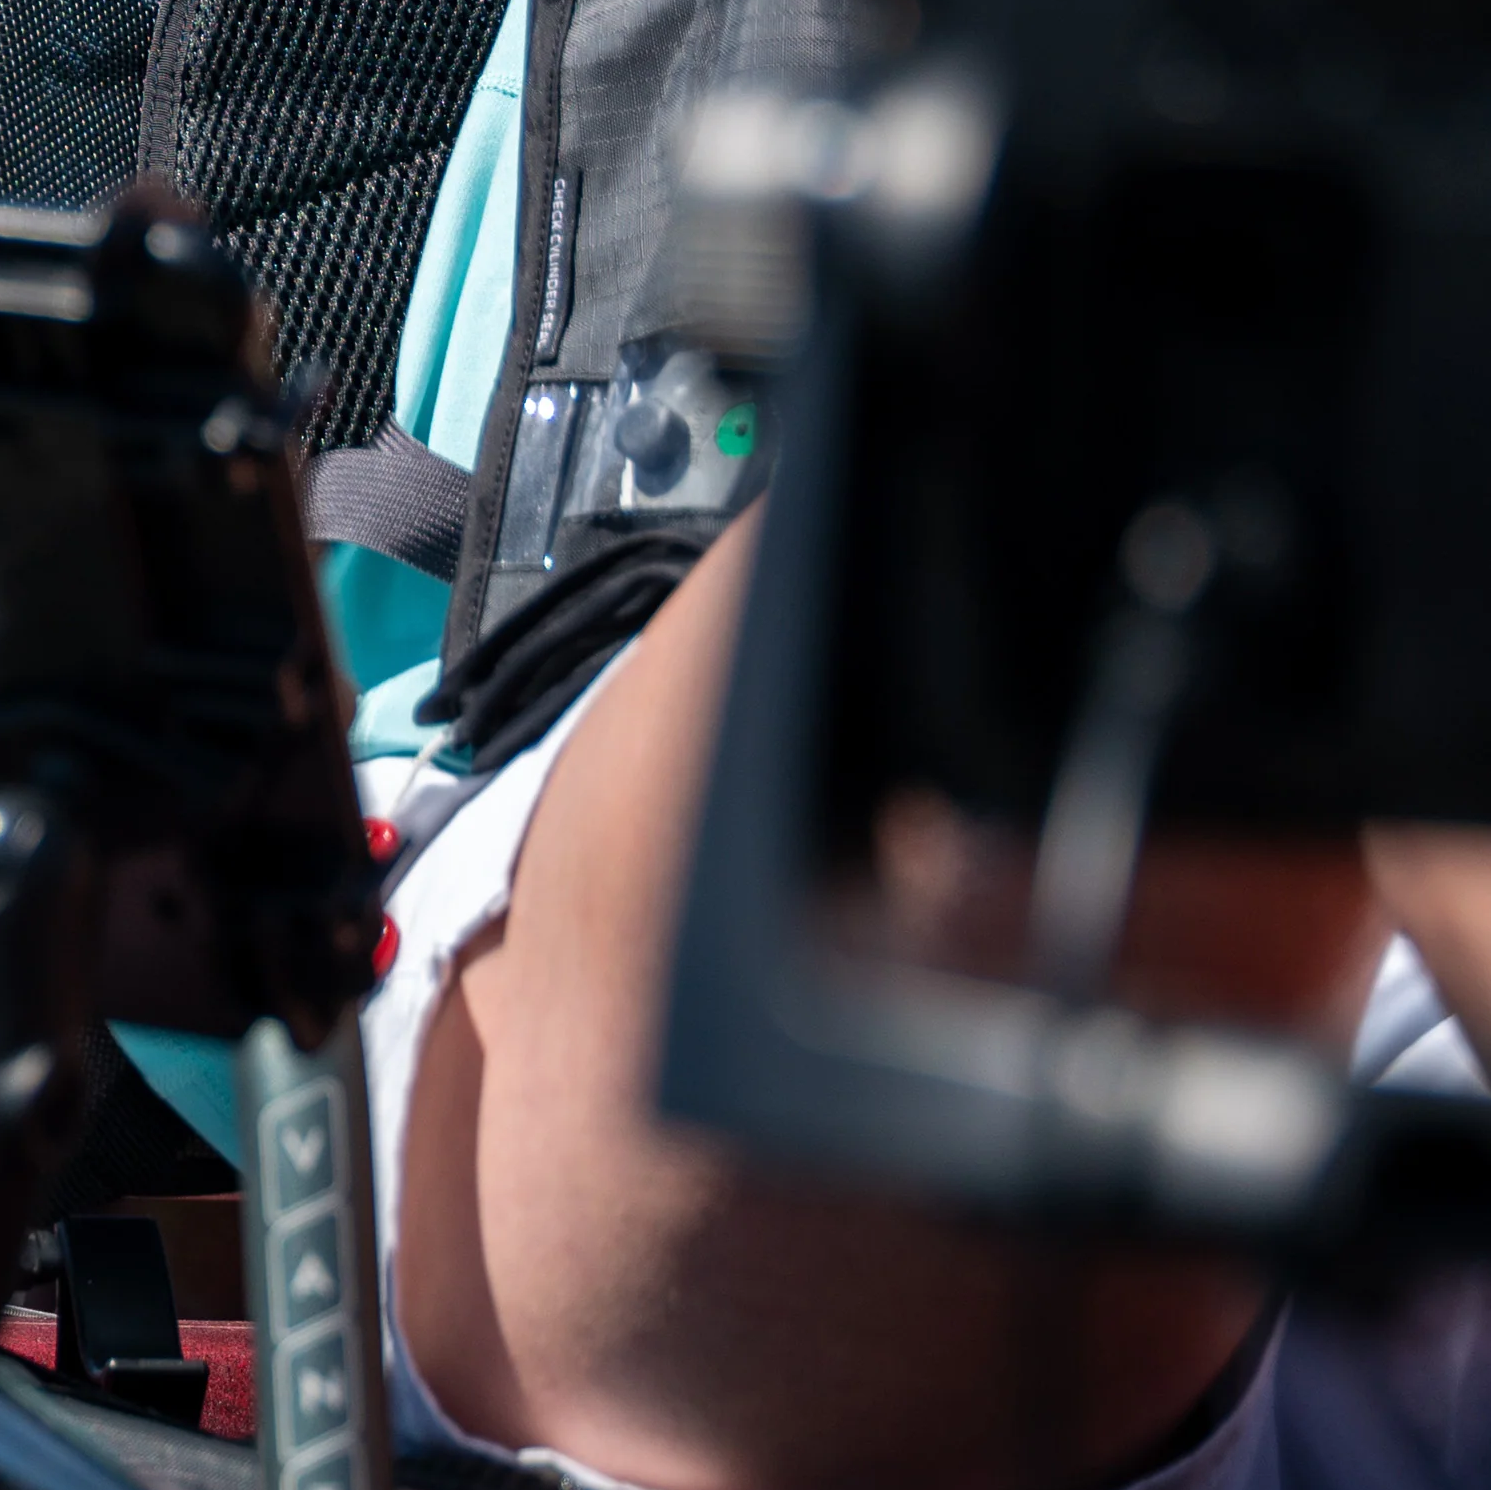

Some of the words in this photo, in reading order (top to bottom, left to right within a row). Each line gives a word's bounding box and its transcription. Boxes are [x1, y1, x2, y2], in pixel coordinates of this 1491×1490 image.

[551, 177, 566, 232] CHECK
[546, 234, 561, 309] CYLINDER
[537, 312, 554, 353] SEAL
